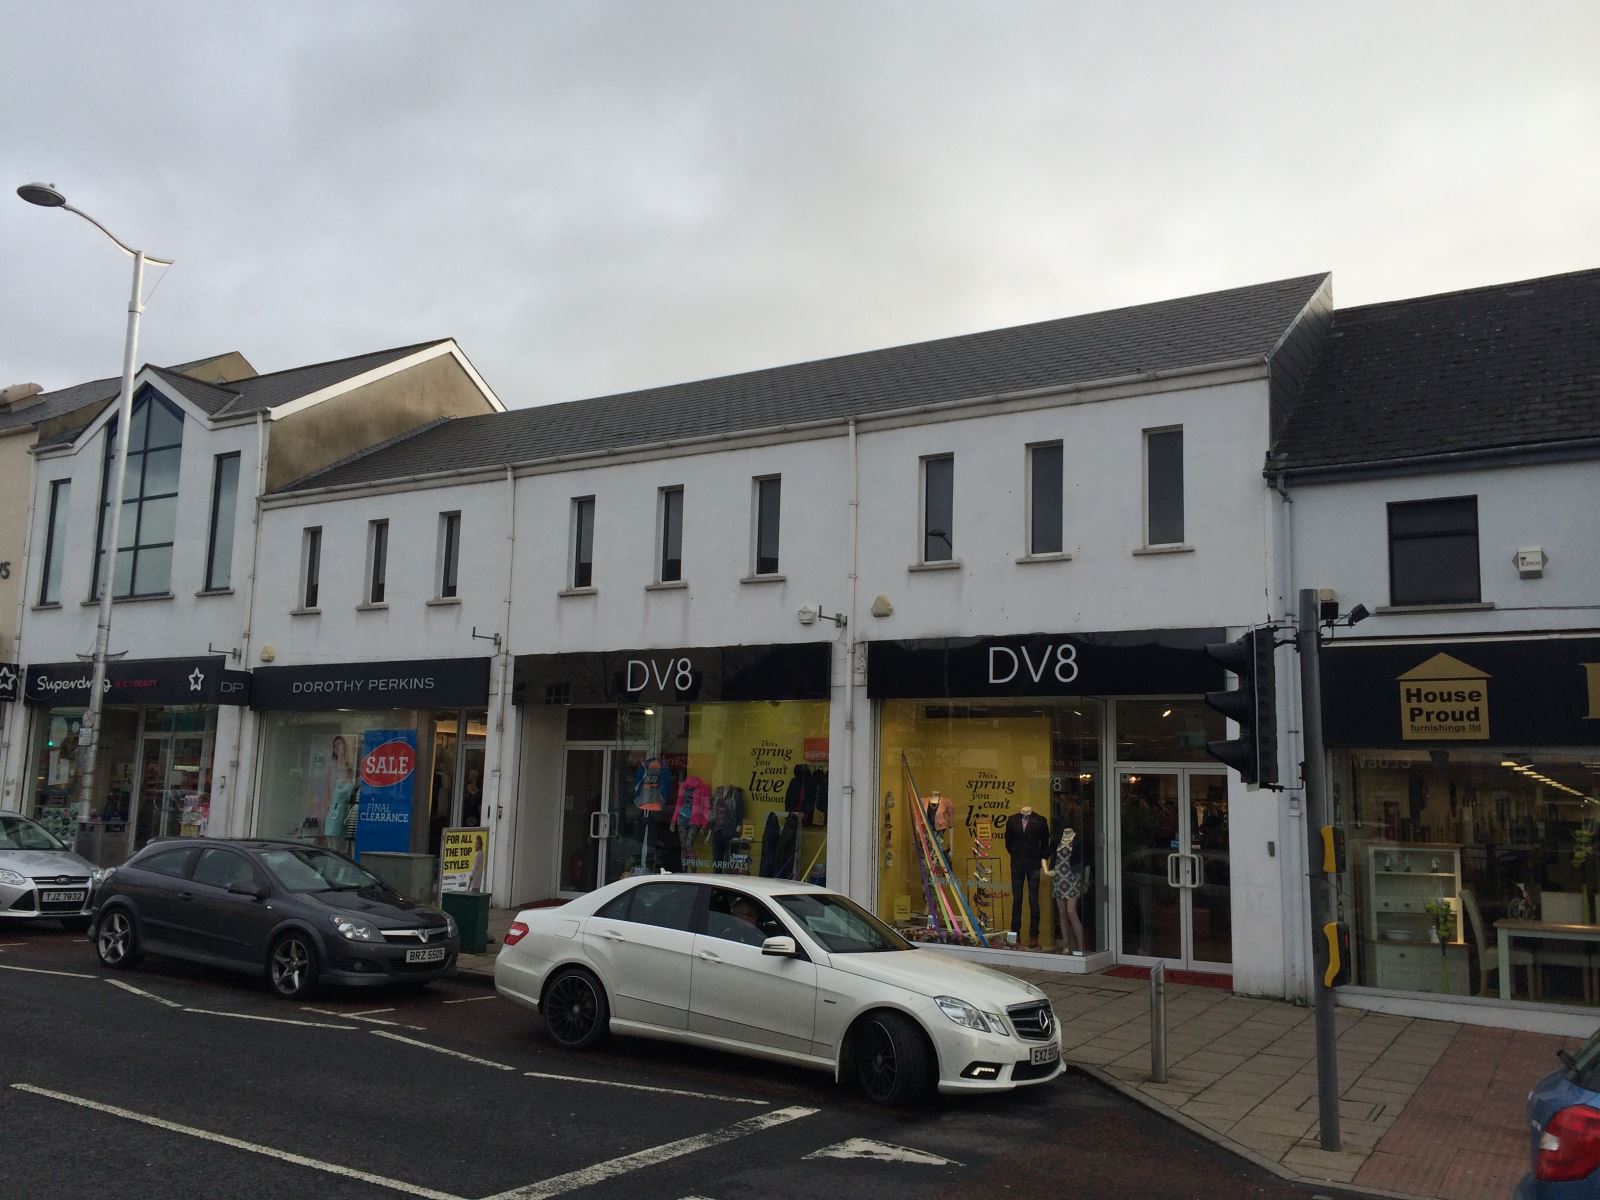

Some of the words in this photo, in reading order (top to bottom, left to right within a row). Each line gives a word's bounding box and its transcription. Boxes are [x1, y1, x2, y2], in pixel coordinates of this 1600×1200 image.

[987, 643, 1079, 684] DV8
[627, 657, 692, 692] DV8
[37, 675, 112, 694] Superdrg
[220, 681, 244, 693] DP
[292, 680, 364, 693] DOROTHY
[368, 677, 435, 691] PERKINS
[1405, 687, 1482, 703] House
[1409, 706, 1480, 722] Proud
[1410, 723, 1466, 733] furnishings
[751, 744, 793, 762] spring
[365, 756, 409, 775] SALE
[754, 760, 770, 768] you
[748, 771, 785, 793] live
[966, 779, 1016, 795] spring
[751, 792, 785, 803] Without
[970, 793, 990, 801] you
[366, 803, 392, 813] FINAL
[360, 812, 409, 823] CLEARANCE
[446, 835, 460, 845] FOR
[460, 834, 473, 844] ALL
[445, 848, 459, 858] THE
[459, 847, 473, 857] TOP
[444, 860, 470, 871] STYLES
[682, 858, 710, 868] SPRING
[711, 860, 749, 871] ARRIVALS
[409, 951, 426, 961] BRZ
[1034, 1049, 1048, 1063] EXZ
